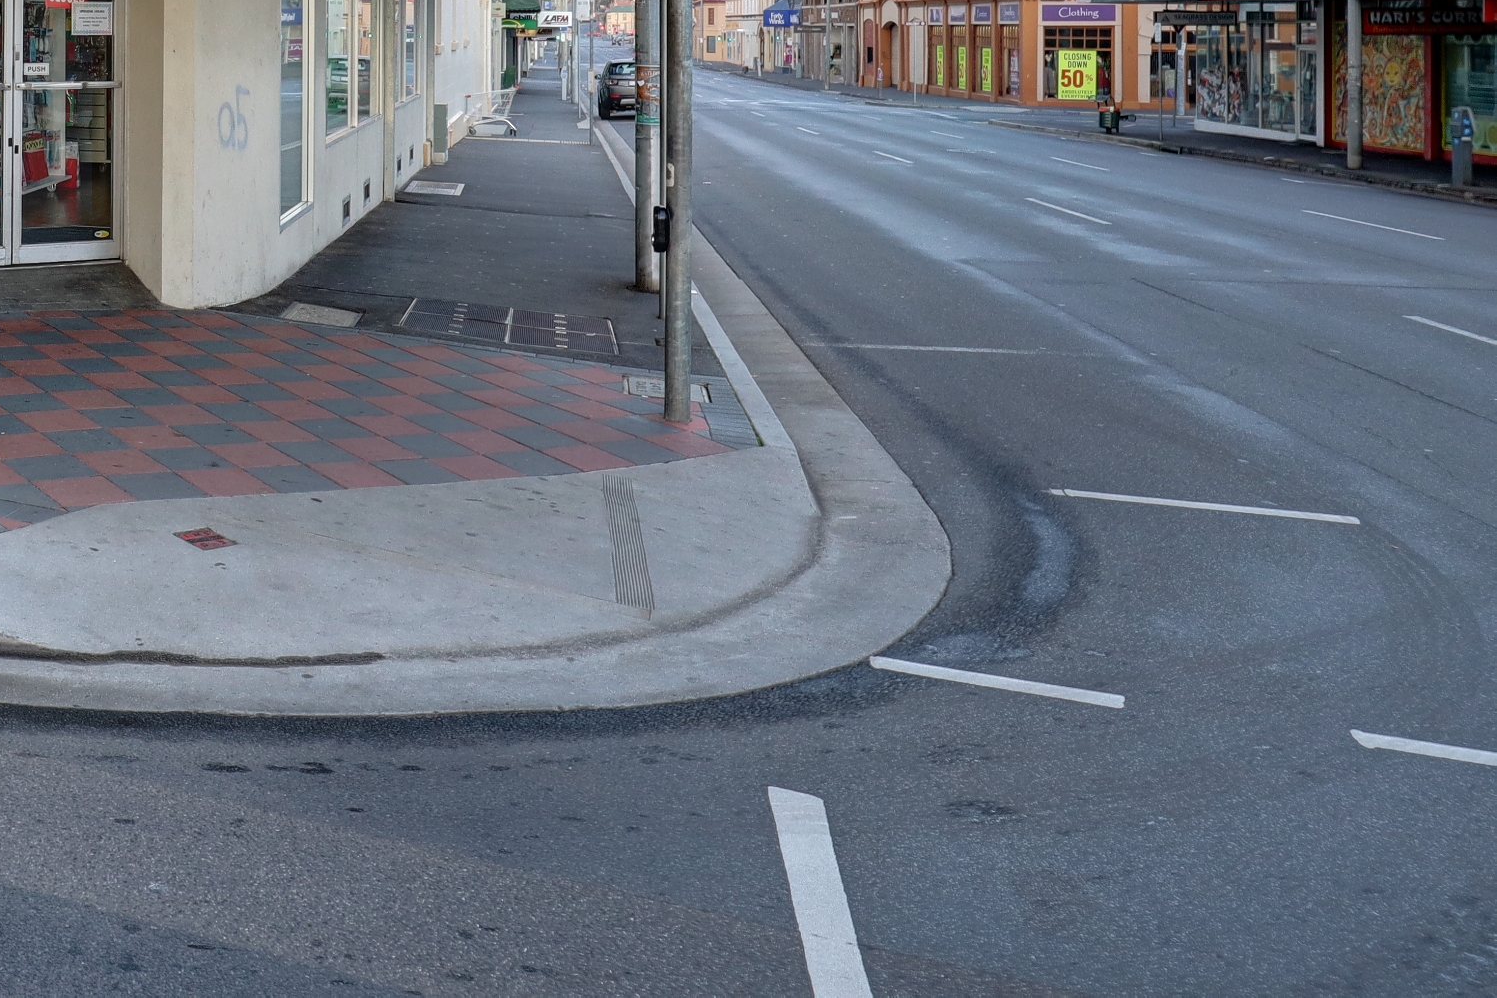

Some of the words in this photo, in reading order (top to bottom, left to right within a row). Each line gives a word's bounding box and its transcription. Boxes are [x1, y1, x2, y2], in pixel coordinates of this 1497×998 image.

[1058, 7, 1099, 19] Clothing
[1370, 11, 1426, 24] HARI'S
[1431, 10, 1484, 23] CURR
[543, 15, 569, 23] LAFM
[1063, 52, 1092, 61] CLOSING
